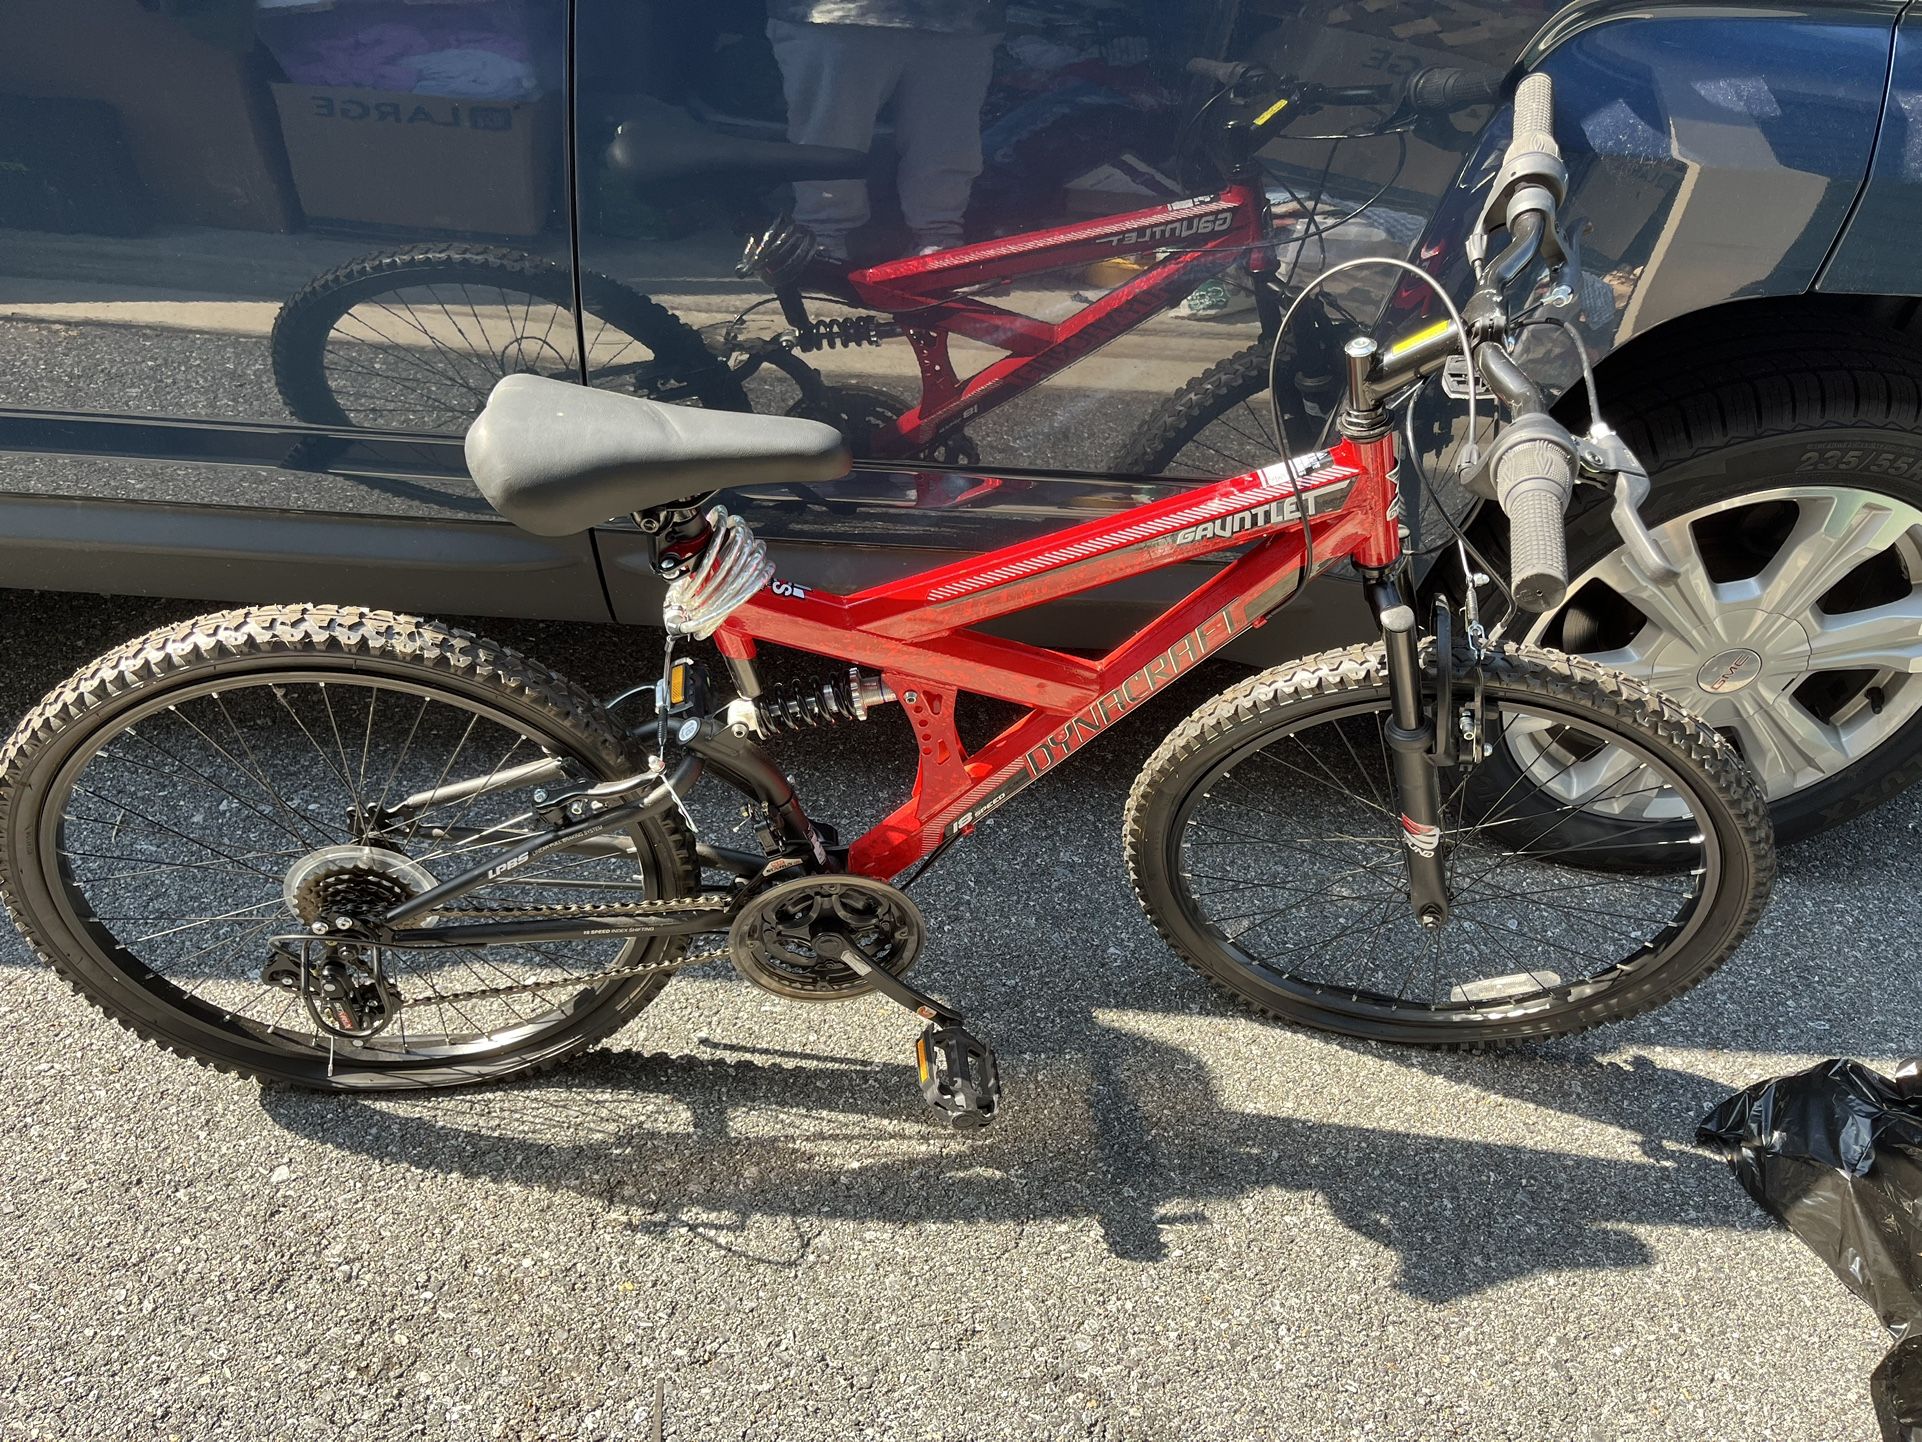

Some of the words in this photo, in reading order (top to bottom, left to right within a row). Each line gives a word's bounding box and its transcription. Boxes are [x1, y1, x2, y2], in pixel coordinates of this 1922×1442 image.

[1177, 480, 1350, 545] GAUNTLET
[1026, 596, 1240, 777] DYNACRAFT
[1711, 654, 1750, 691] GMC
[953, 811, 973, 834] 18
[488, 851, 529, 880] LPBS
